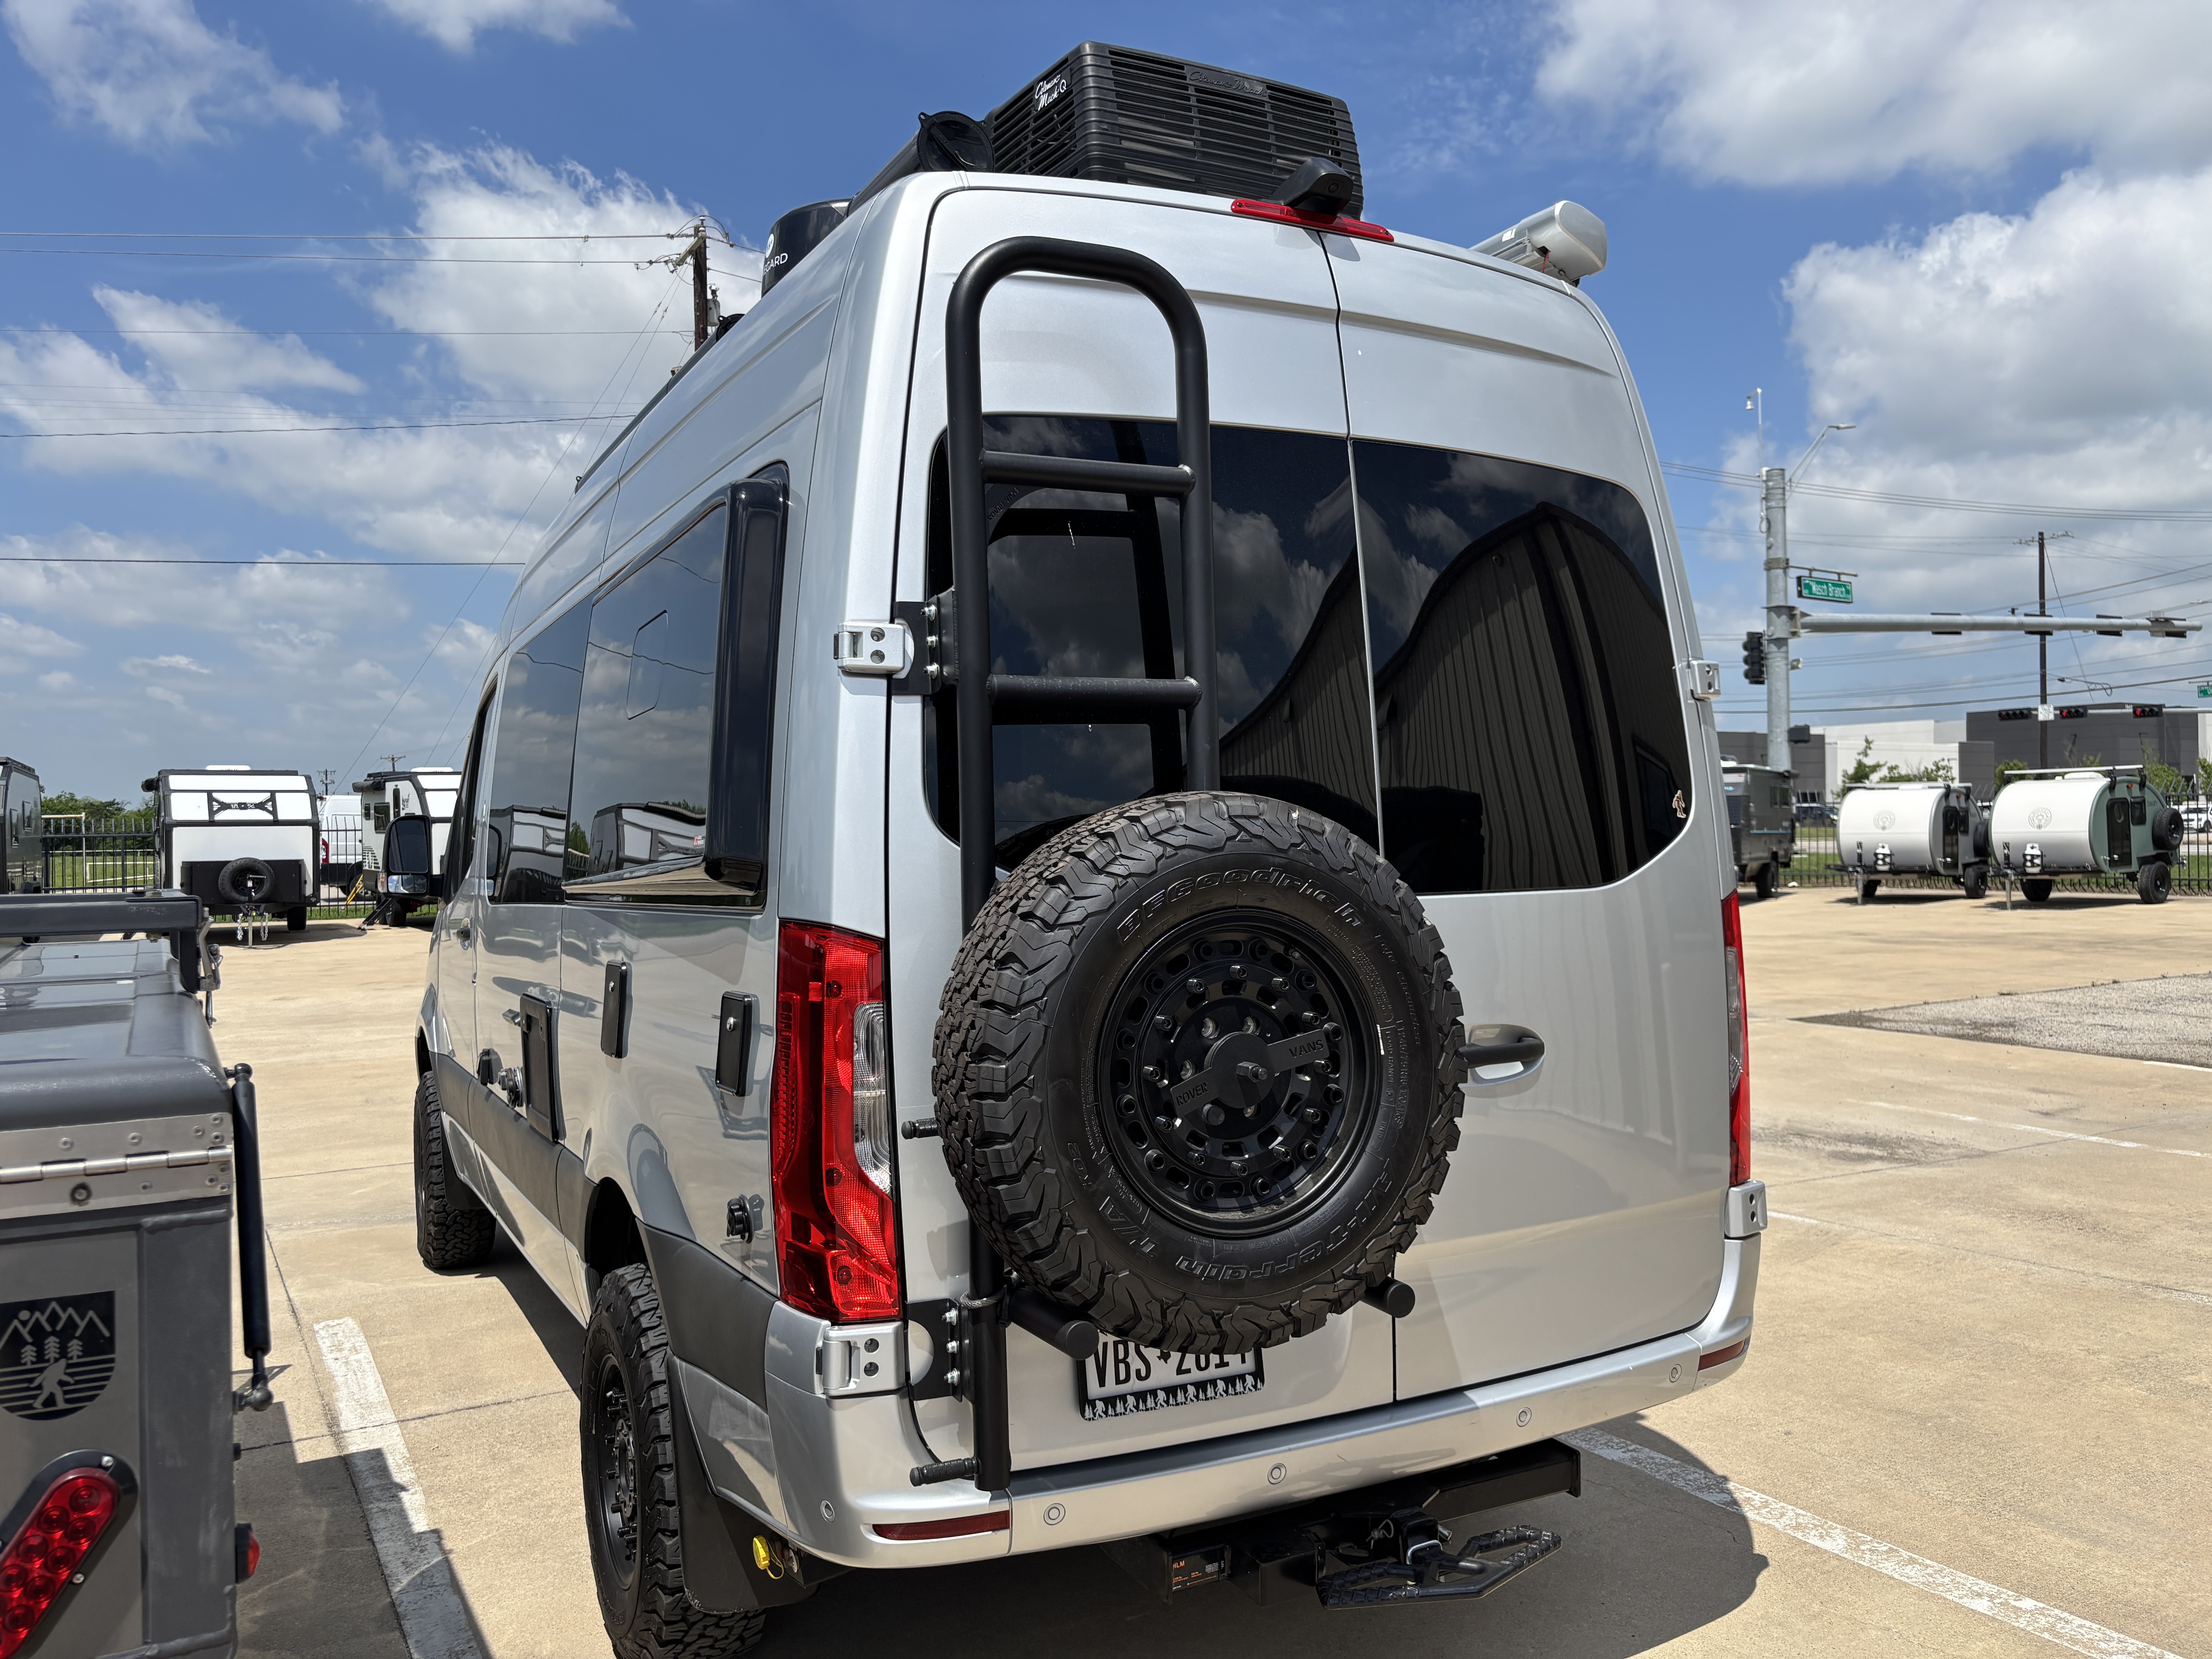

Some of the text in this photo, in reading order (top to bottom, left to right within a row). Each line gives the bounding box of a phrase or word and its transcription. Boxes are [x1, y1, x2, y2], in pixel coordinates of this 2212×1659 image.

[1060, 79, 1066, 93] Q
[1117, 867, 1364, 943] BFGoodrich
[1289, 1039, 1324, 1058] VANS
[1176, 1082, 1209, 1107] ROVER
[1068, 1143, 1094, 1190] KO2
[1093, 1340, 1151, 1388] VBS
